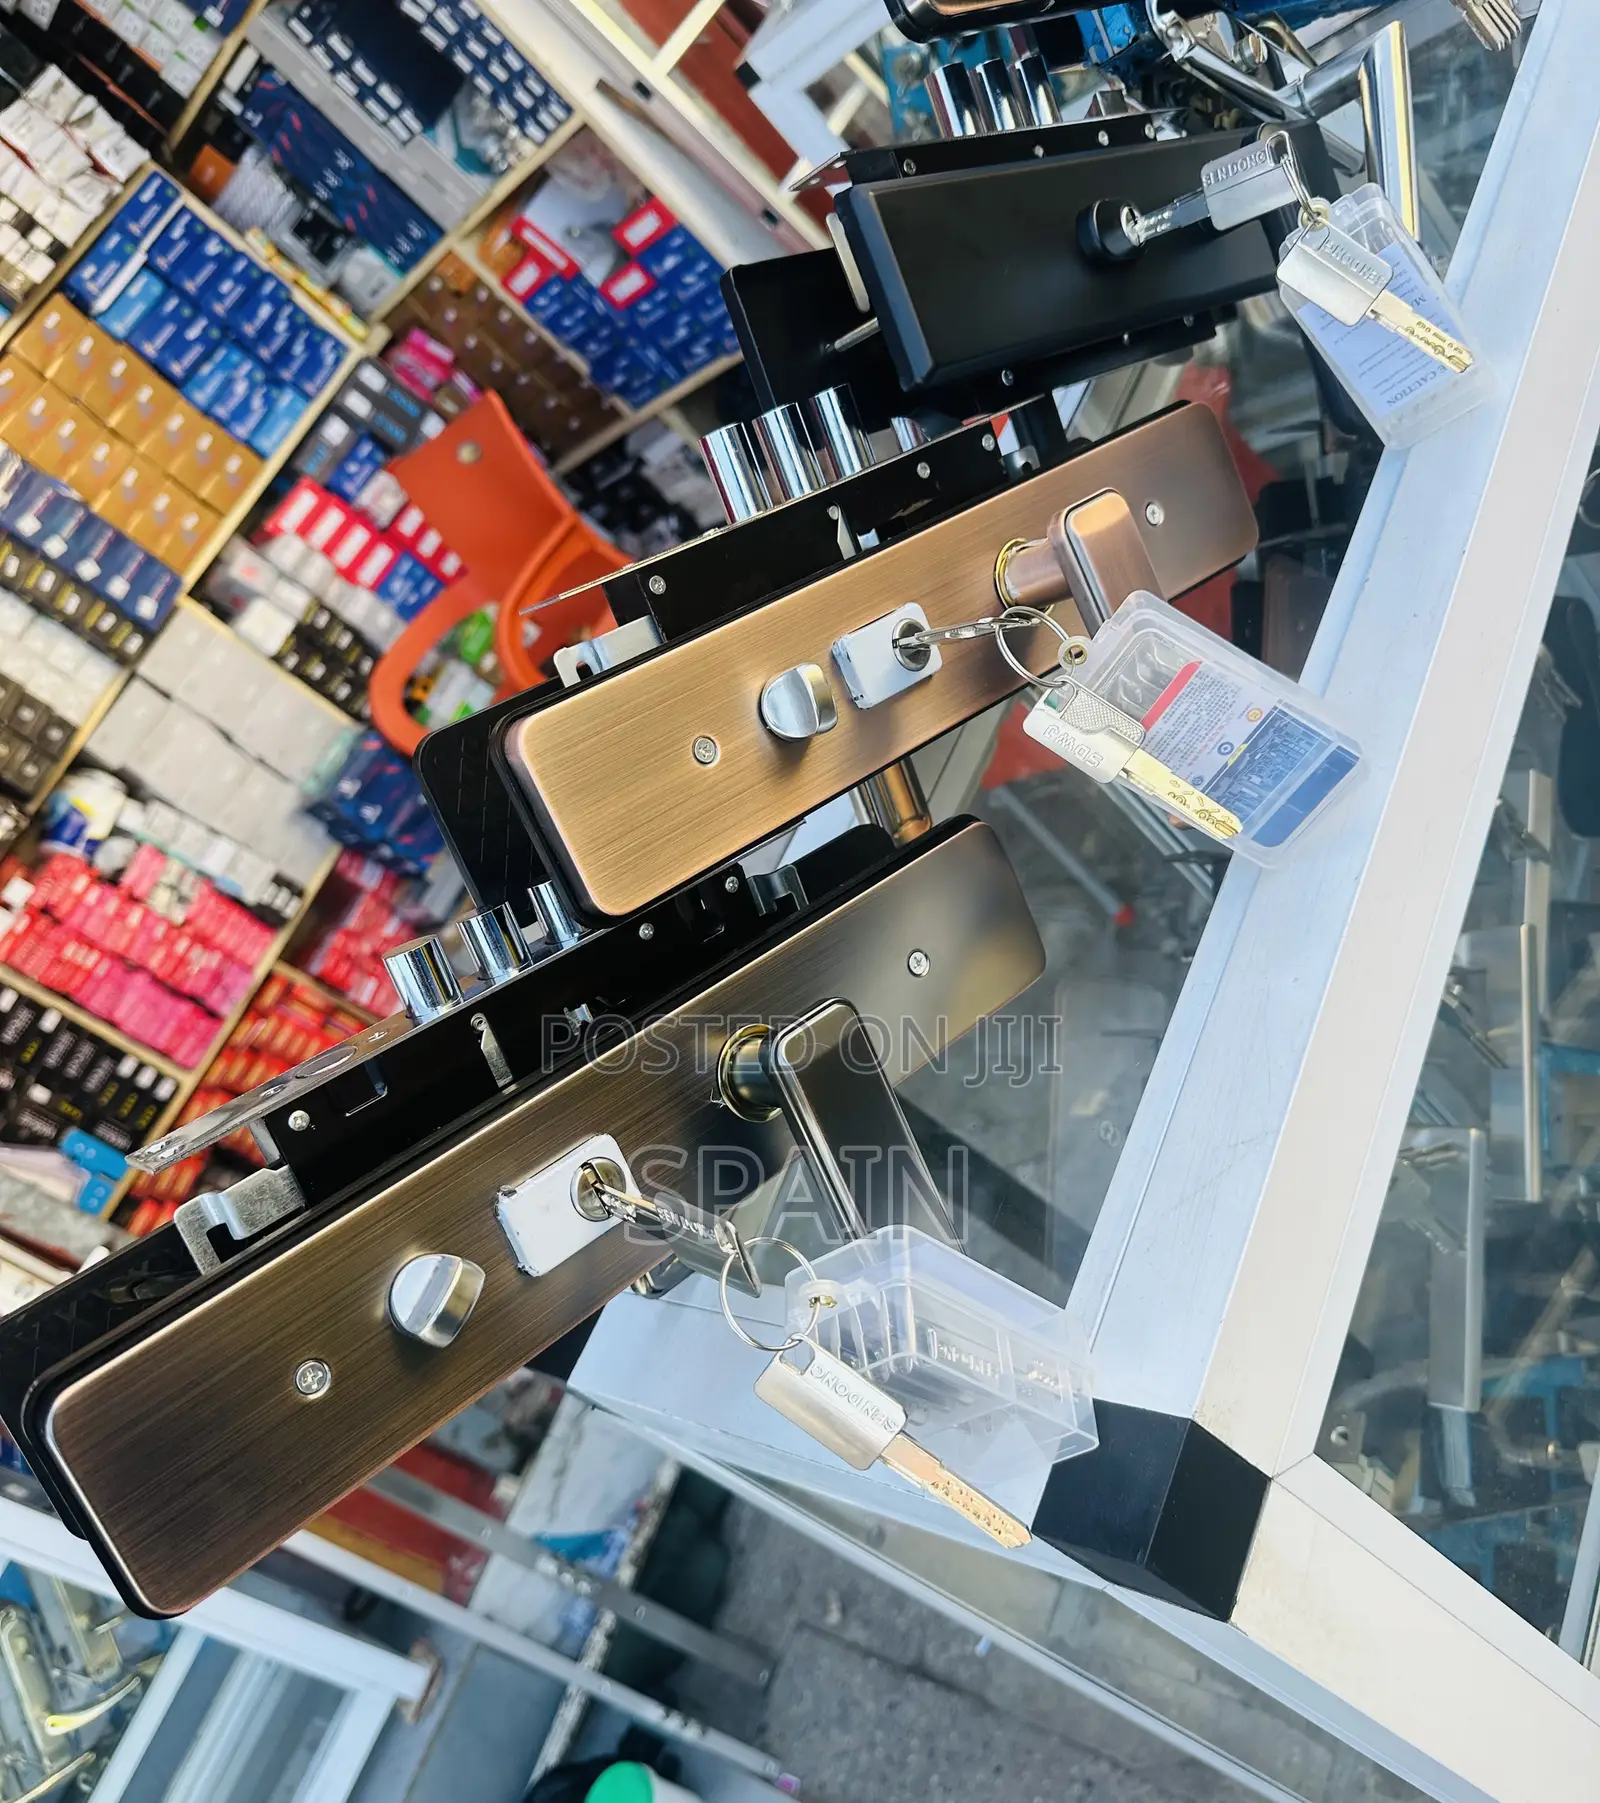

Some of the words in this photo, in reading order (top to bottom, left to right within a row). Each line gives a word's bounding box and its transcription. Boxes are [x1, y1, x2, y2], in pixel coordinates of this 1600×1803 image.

[1202, 150, 1266, 187] SENDONG
[1386, 370, 1437, 407] CAUTION
[810, 1363, 898, 1432] SENDONG
